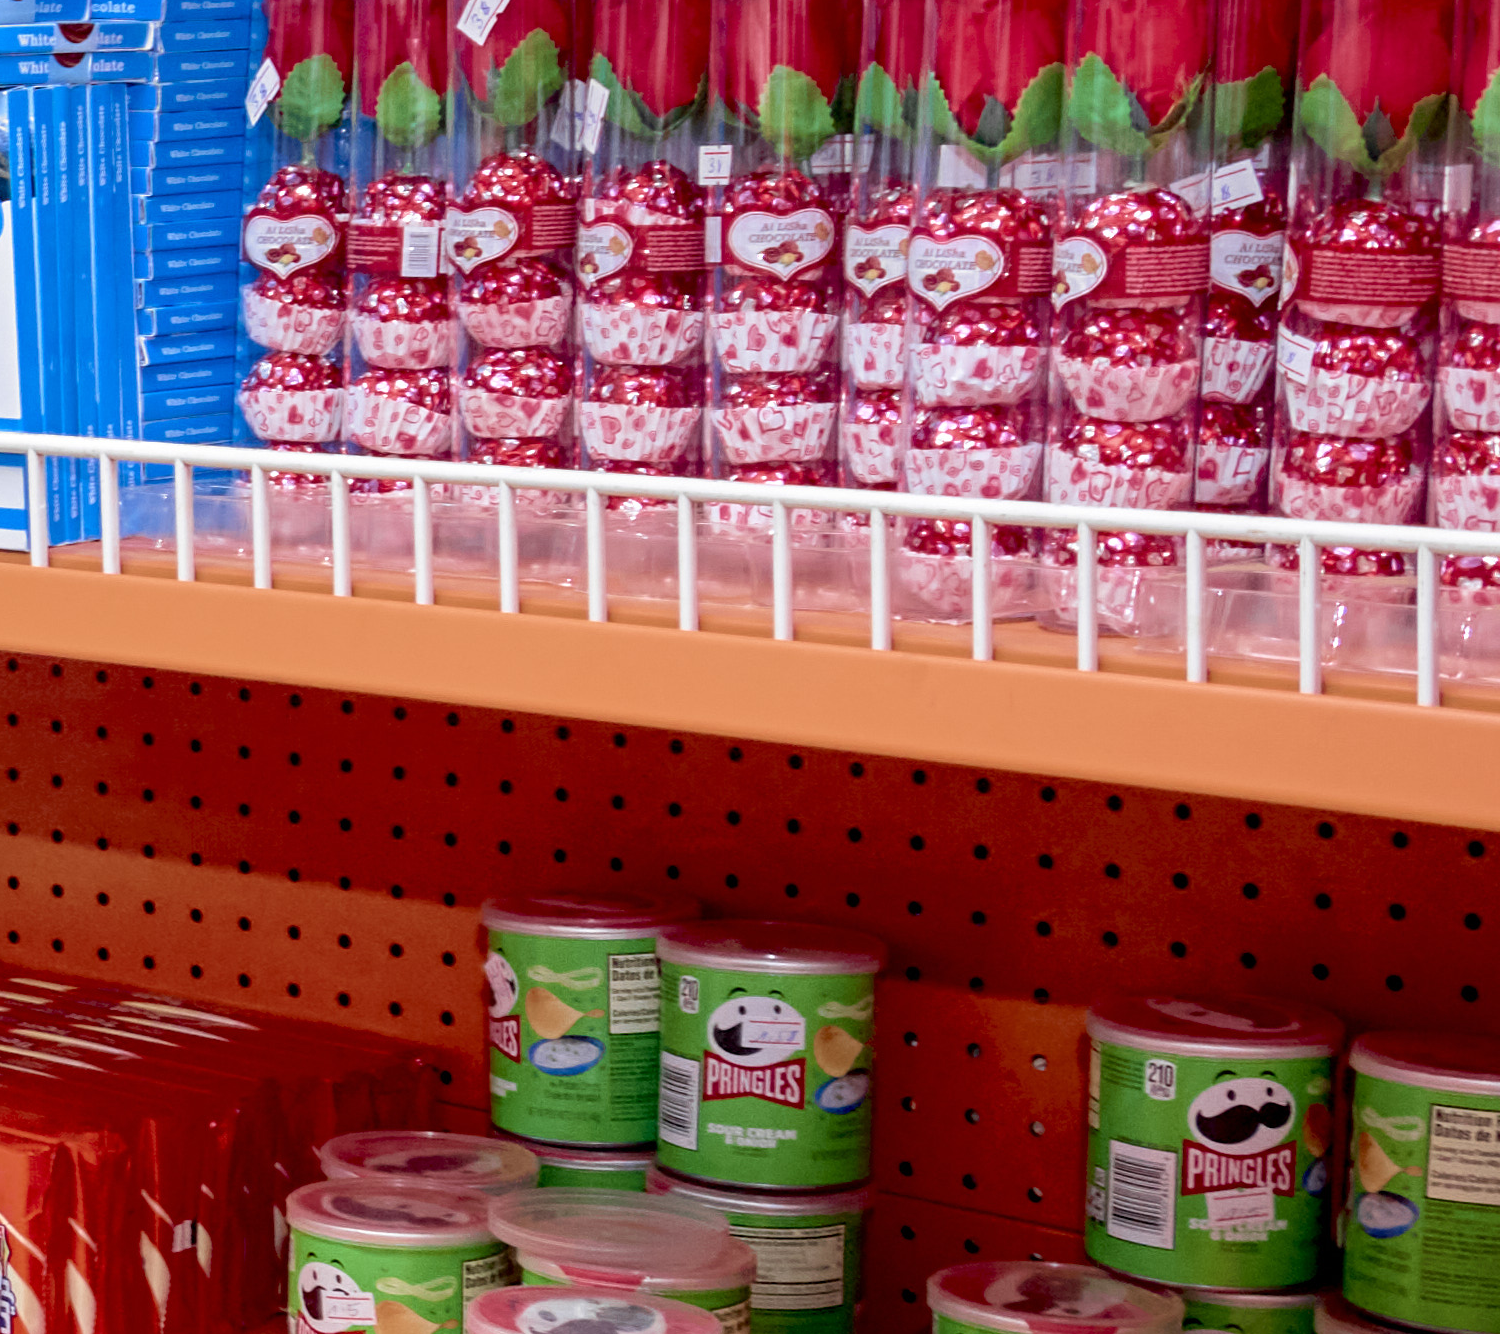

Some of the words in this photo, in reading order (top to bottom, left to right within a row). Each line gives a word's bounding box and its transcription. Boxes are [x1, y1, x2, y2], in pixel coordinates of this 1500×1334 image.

[705, 1065, 802, 1105] PRINGLES
[1148, 1062, 1175, 1087] 210
[1187, 1146, 1292, 1194] PRINGLES
